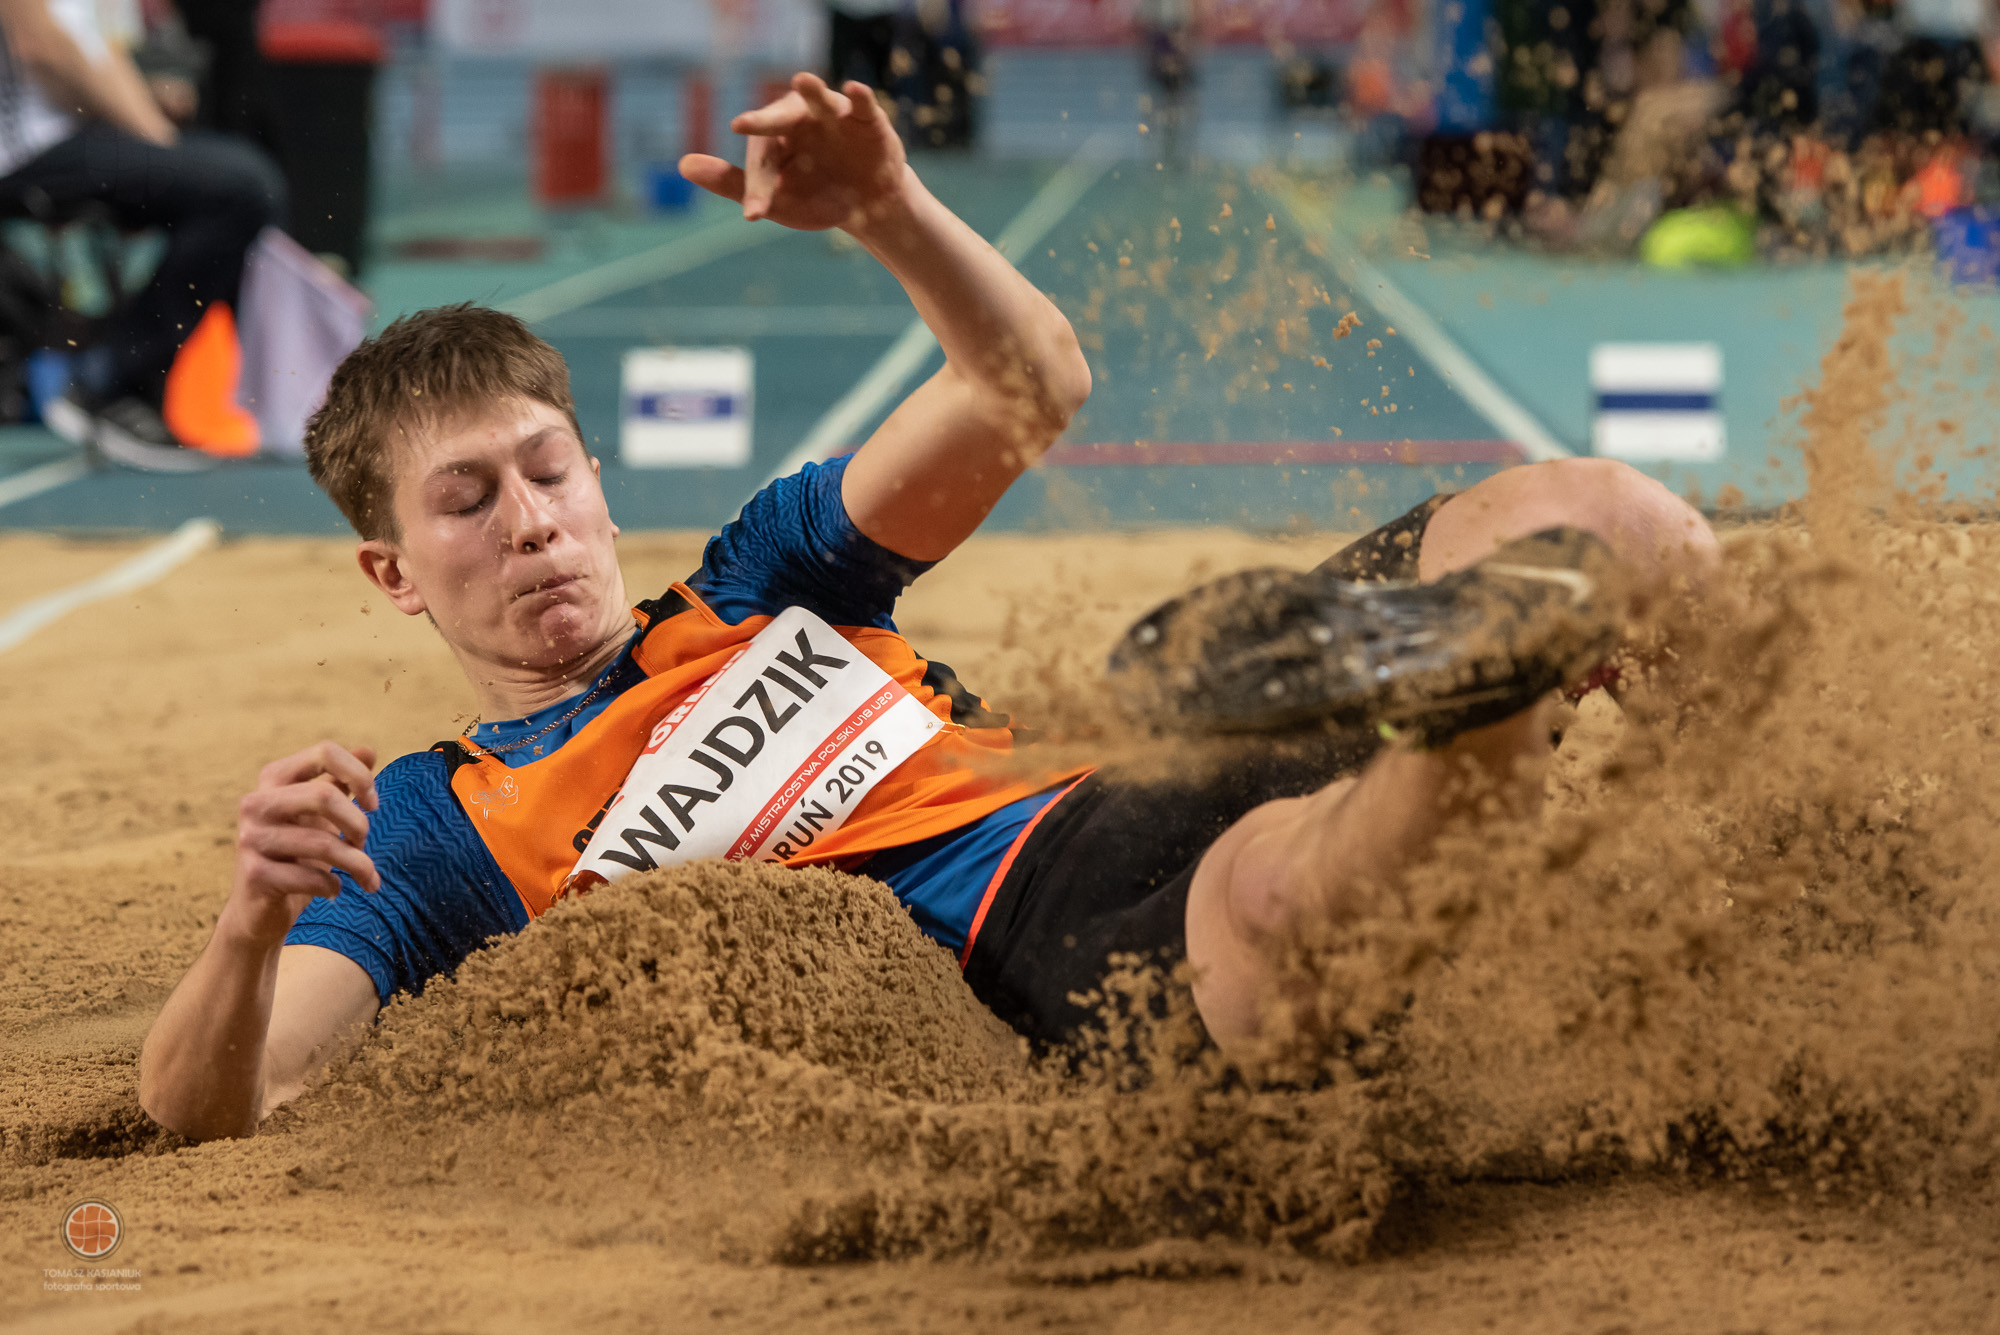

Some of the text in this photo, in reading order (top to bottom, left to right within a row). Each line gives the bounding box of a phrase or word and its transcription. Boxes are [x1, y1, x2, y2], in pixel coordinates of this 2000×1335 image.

[599, 627, 850, 872] WAJDZIK
[749, 761, 822, 842] MISTRZOSTWA
[818, 725, 856, 761] POLSKI
[852, 708, 873, 726] U18
[870, 691, 893, 710] U20
[761, 740, 888, 863] RUŃ 2019
